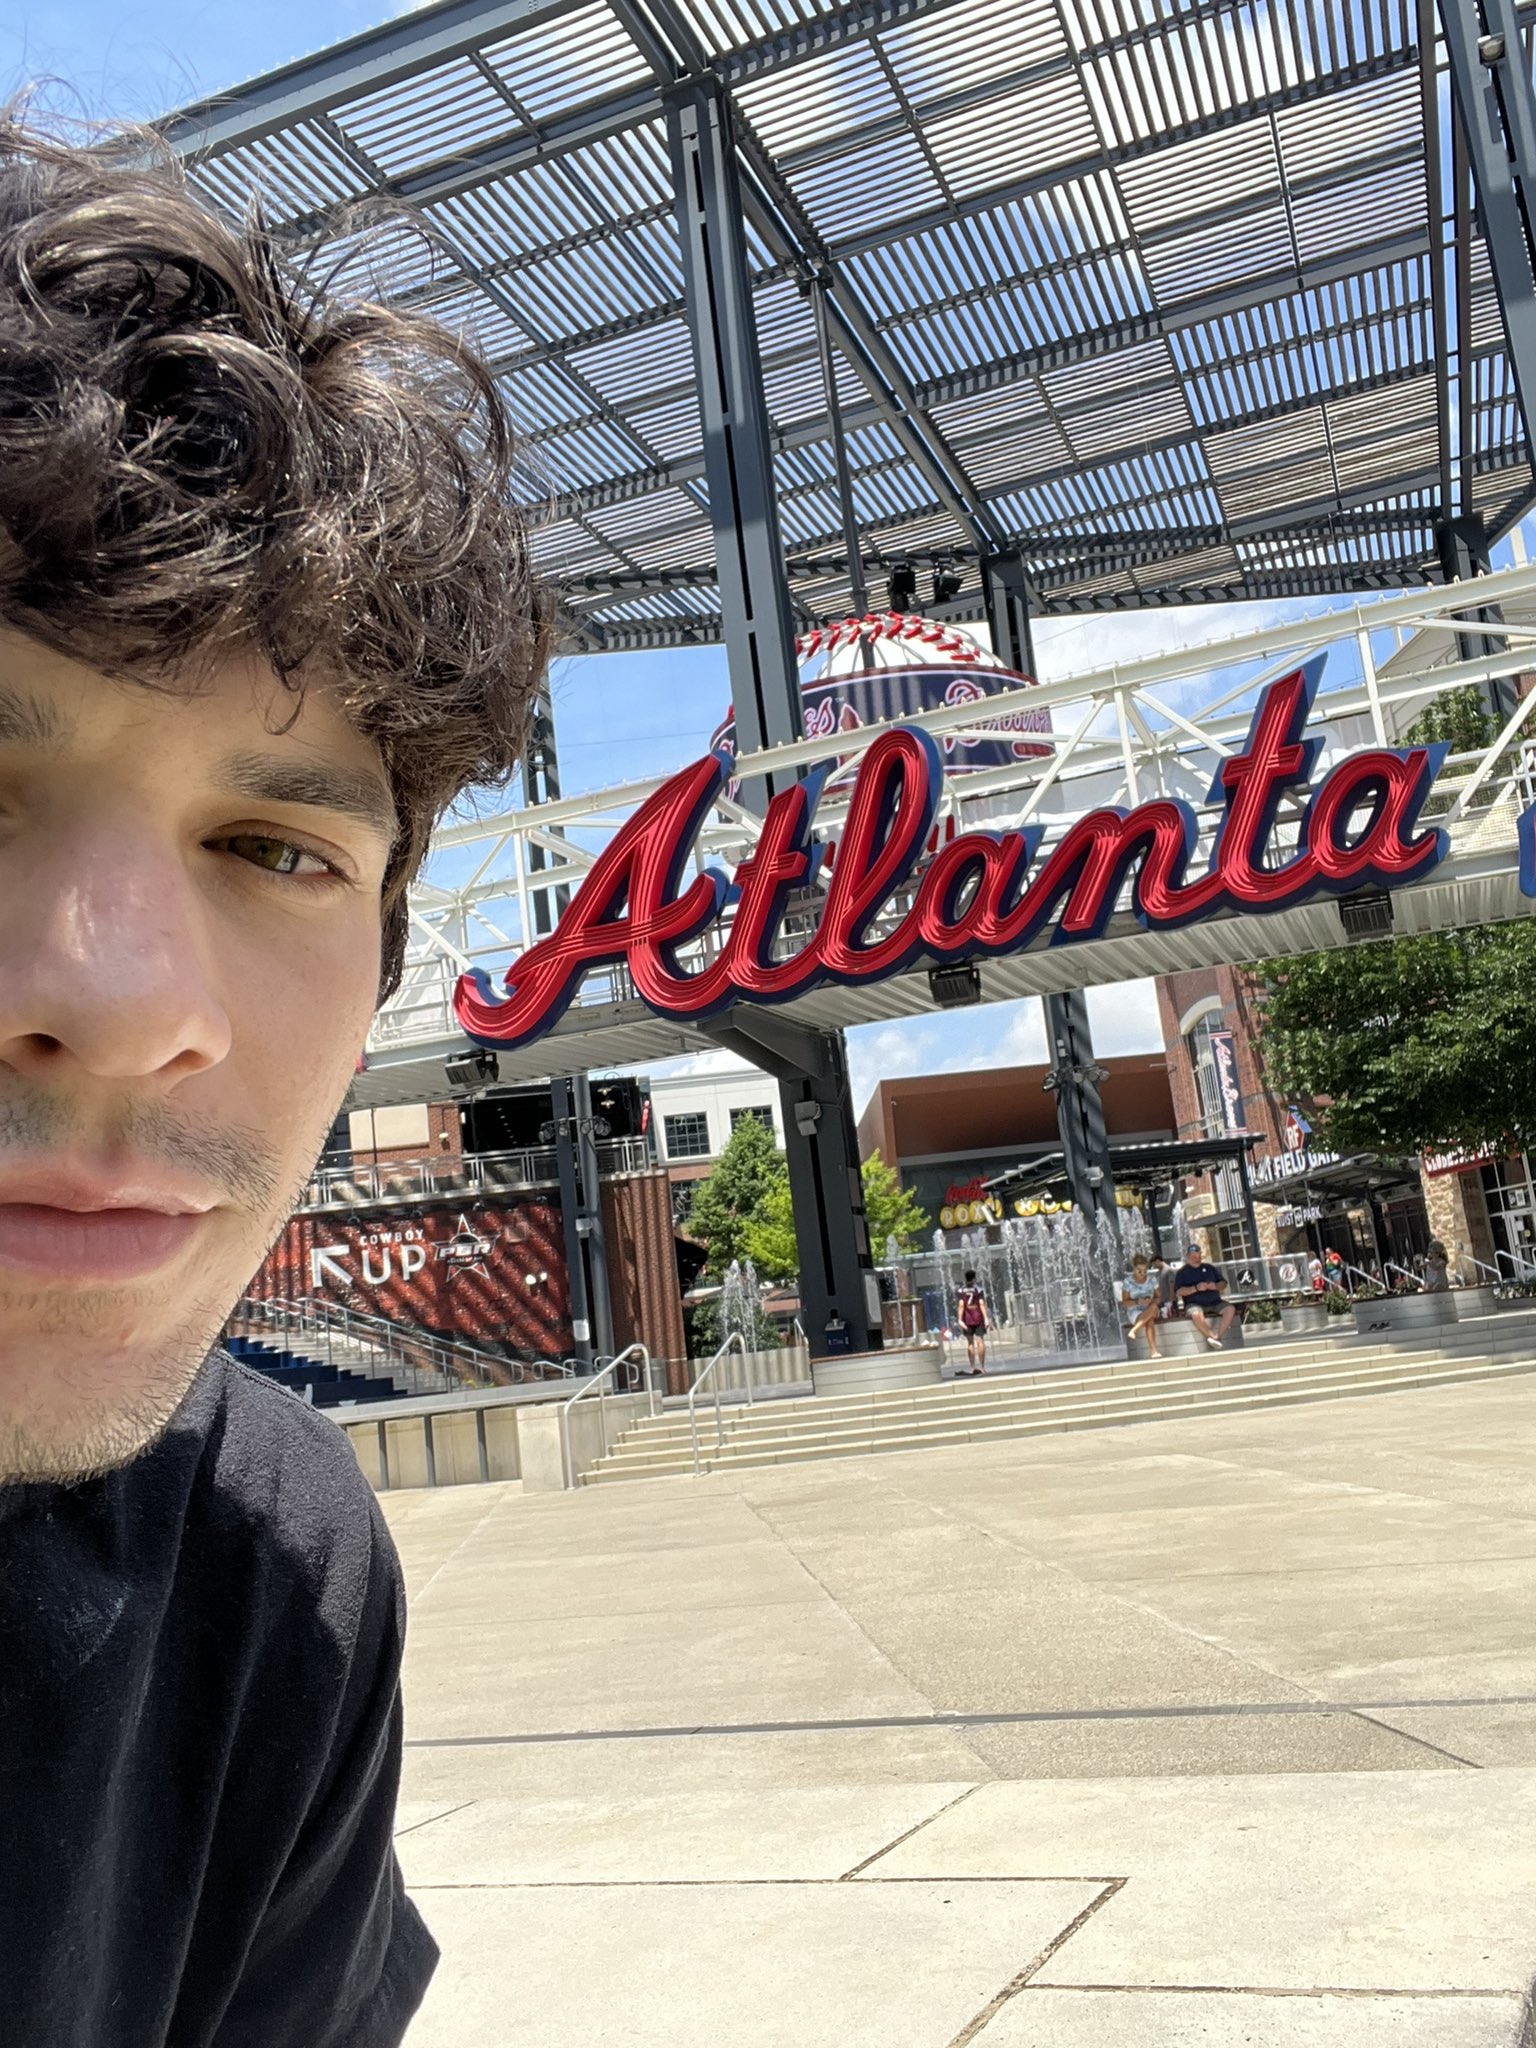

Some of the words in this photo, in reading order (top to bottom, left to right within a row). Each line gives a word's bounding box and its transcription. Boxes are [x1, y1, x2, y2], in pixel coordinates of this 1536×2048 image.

[455, 653, 1450, 1049] Atlanta
[1273, 1150, 1305, 1179] FIELD
[360, 1229, 424, 1246] COWBOY
[439, 1243, 491, 1259] PBR
[965, 1292, 974, 1305] 7
